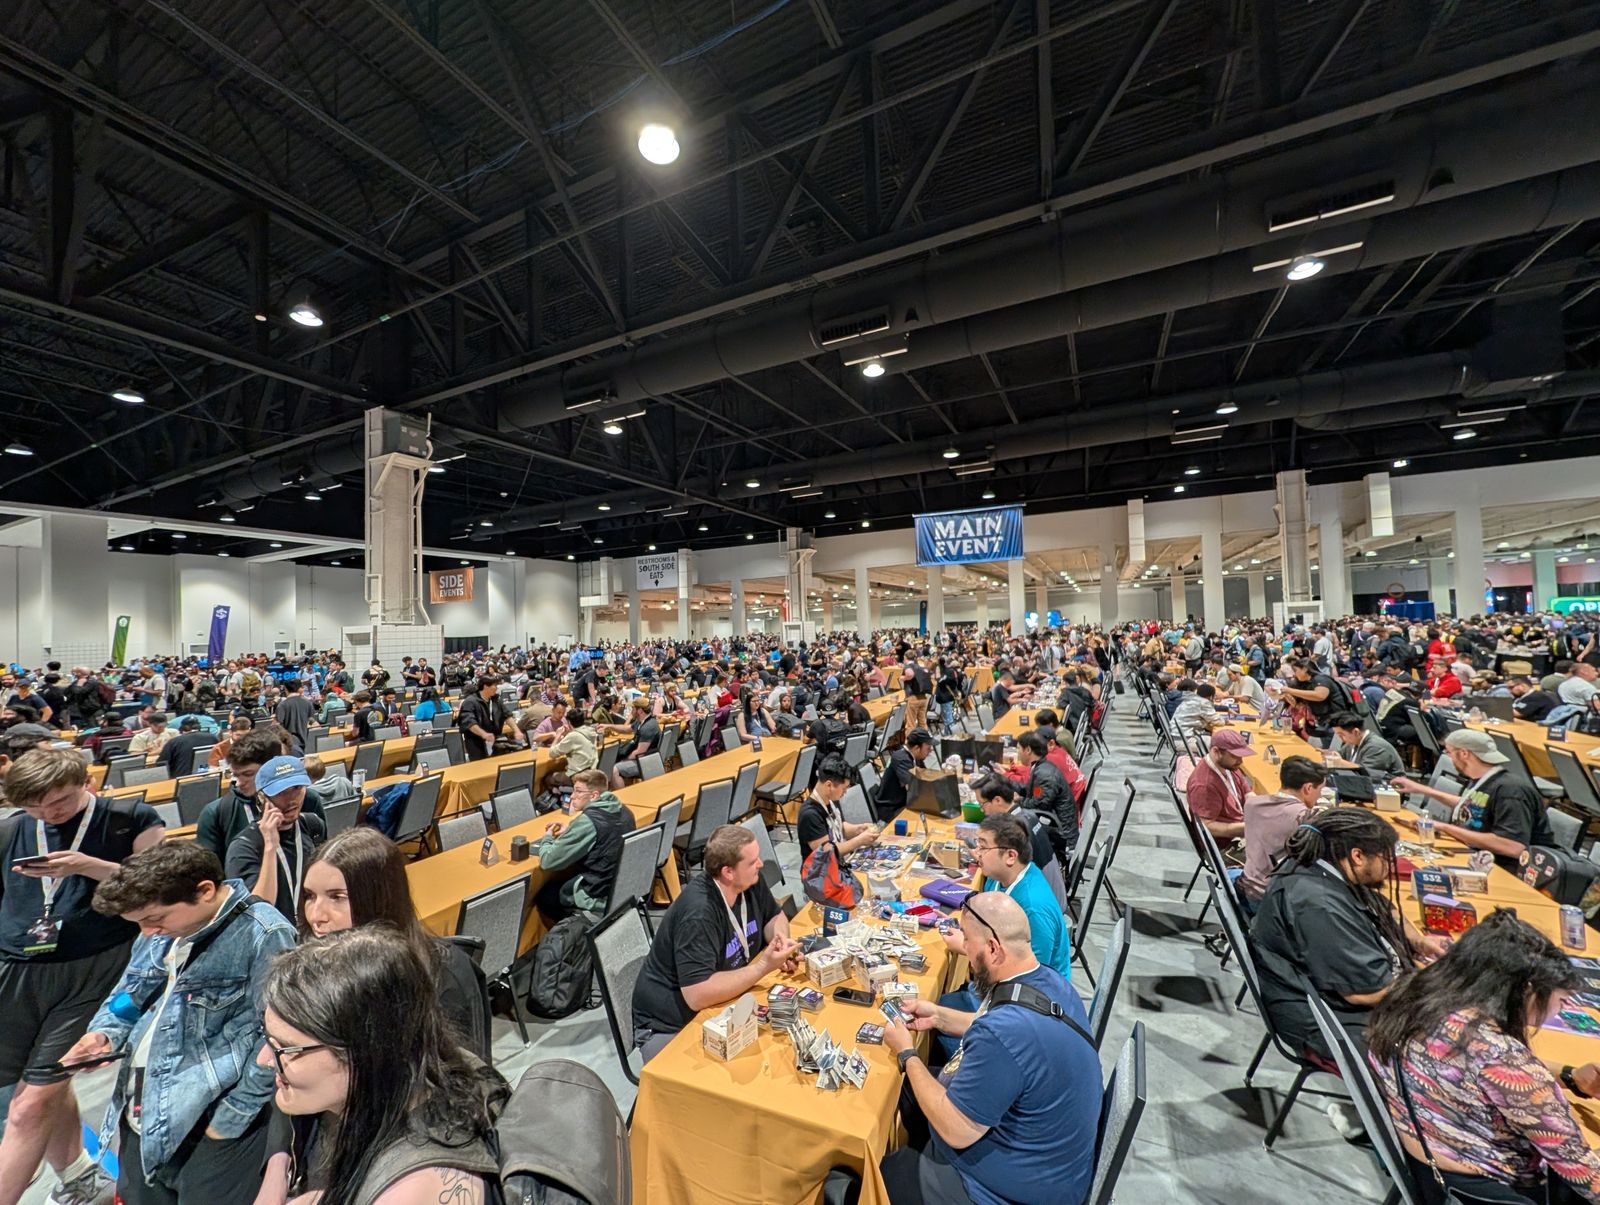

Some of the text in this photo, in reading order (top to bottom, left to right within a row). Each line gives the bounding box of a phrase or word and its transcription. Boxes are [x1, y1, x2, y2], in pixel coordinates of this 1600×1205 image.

[934, 515, 1002, 540] MAIN
[935, 536, 1003, 557] EVENT
[638, 557, 671, 565] RESTROOMS
[661, 562, 675, 571] SIDE
[650, 571, 664, 579] EATS
[439, 574, 464, 588] SIDE
[439, 587, 464, 598] EVENTS
[1422, 873, 1442, 883] 532
[829, 911, 843, 921] 535
